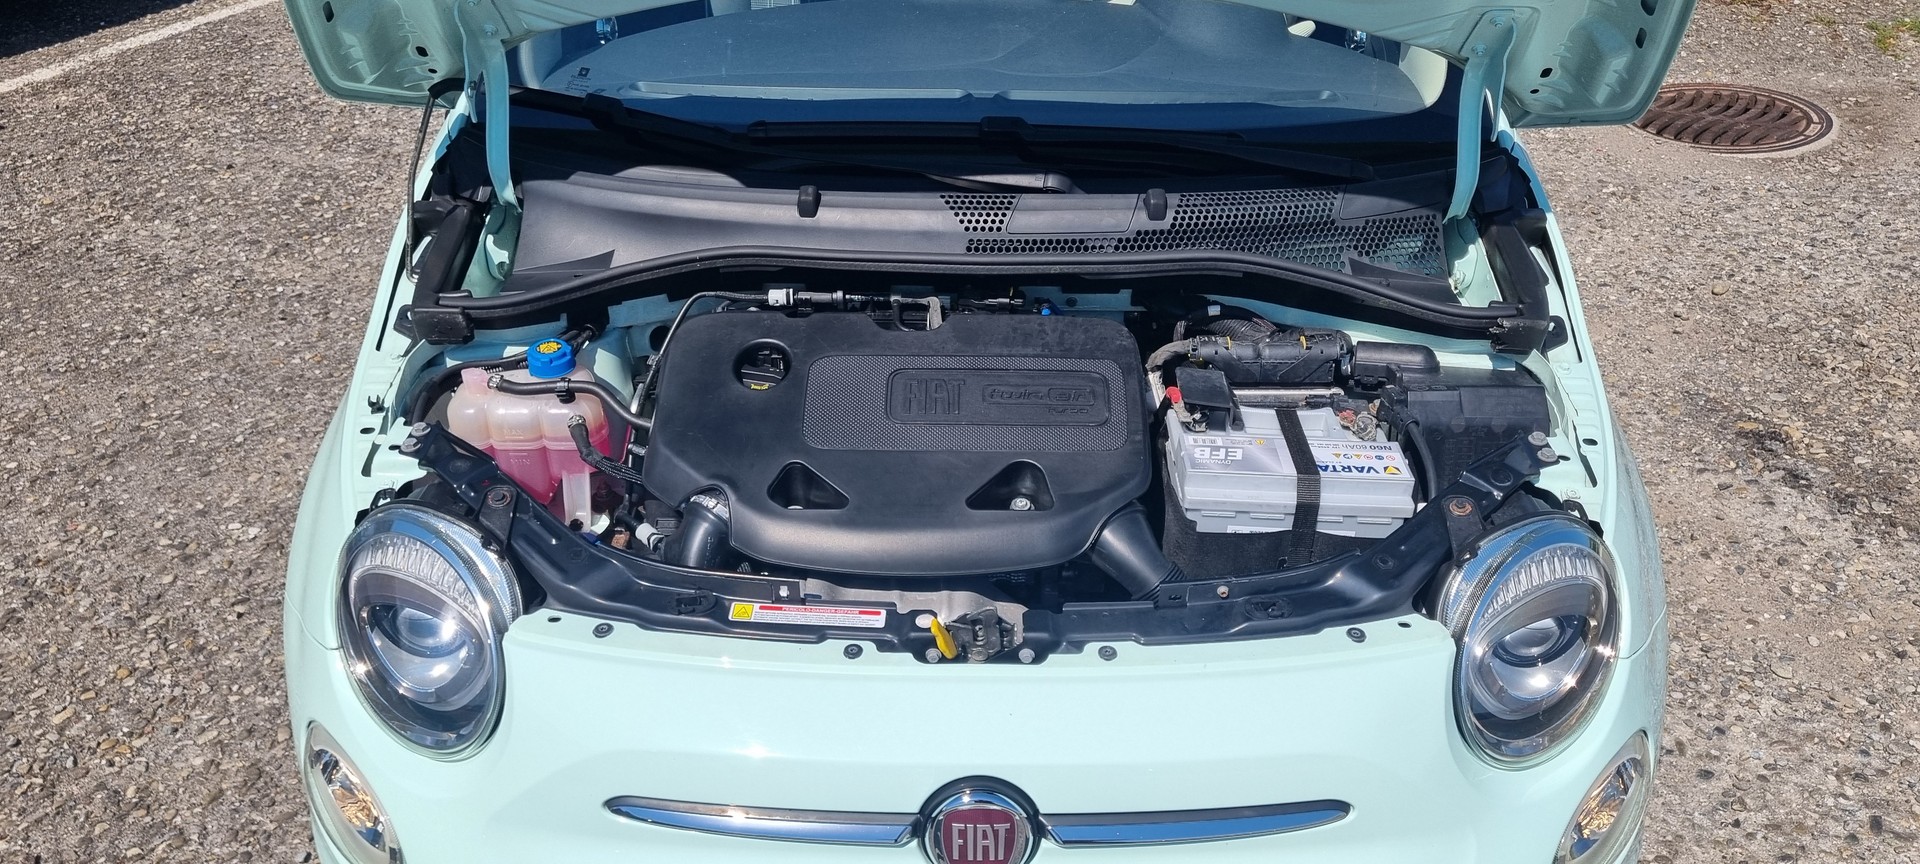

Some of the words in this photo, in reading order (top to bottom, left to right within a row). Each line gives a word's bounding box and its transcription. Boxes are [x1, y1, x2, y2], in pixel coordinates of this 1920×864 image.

[905, 378, 966, 415] FIAT
[1194, 447, 1243, 460] EFB
[1317, 464, 1380, 474] VARTA
[952, 823, 1011, 861] FIAT
